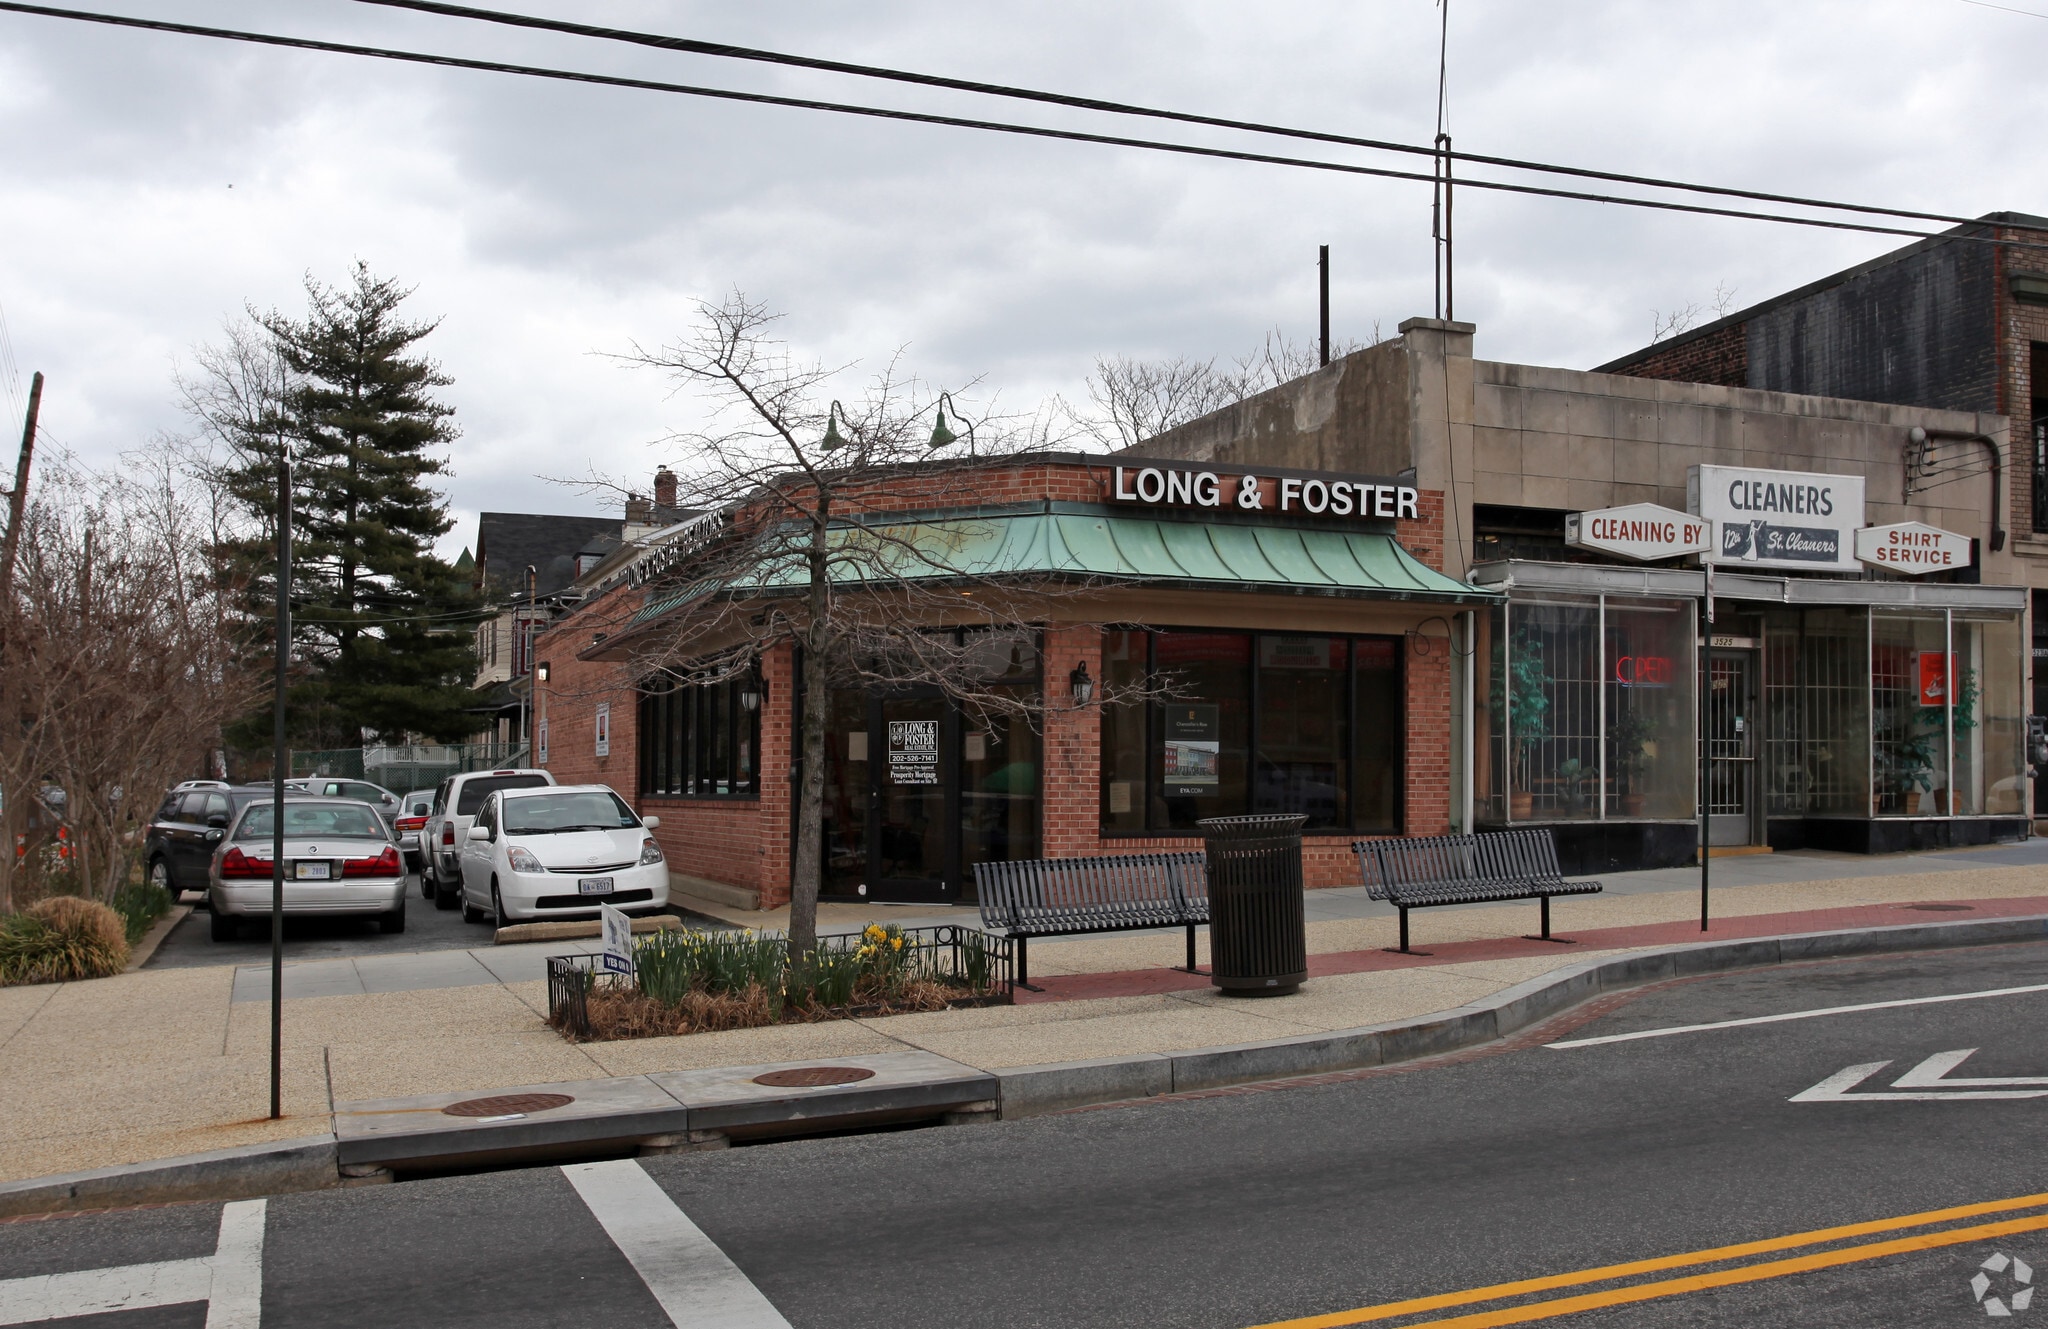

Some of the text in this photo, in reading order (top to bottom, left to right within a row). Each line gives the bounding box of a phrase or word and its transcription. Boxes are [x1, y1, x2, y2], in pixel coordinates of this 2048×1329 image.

[1115, 466, 1418, 519] LONG & FOSTER
[1728, 479, 1833, 517] CLEANERS
[1591, 518, 1676, 545] CLEANING
[1683, 522, 1703, 545] BY
[1889, 531, 1942, 548] SHIRT
[1767, 531, 1784, 550] St.
[1785, 532, 1837, 553] Cleaners
[1876, 547, 1952, 566] SERVICE
[1714, 638, 1733, 646] 3525
[905, 722, 926, 734] LONG
[927, 722, 934, 734] &
[905, 733, 935, 745] FOSTER
[606, 957, 618, 968] YES
